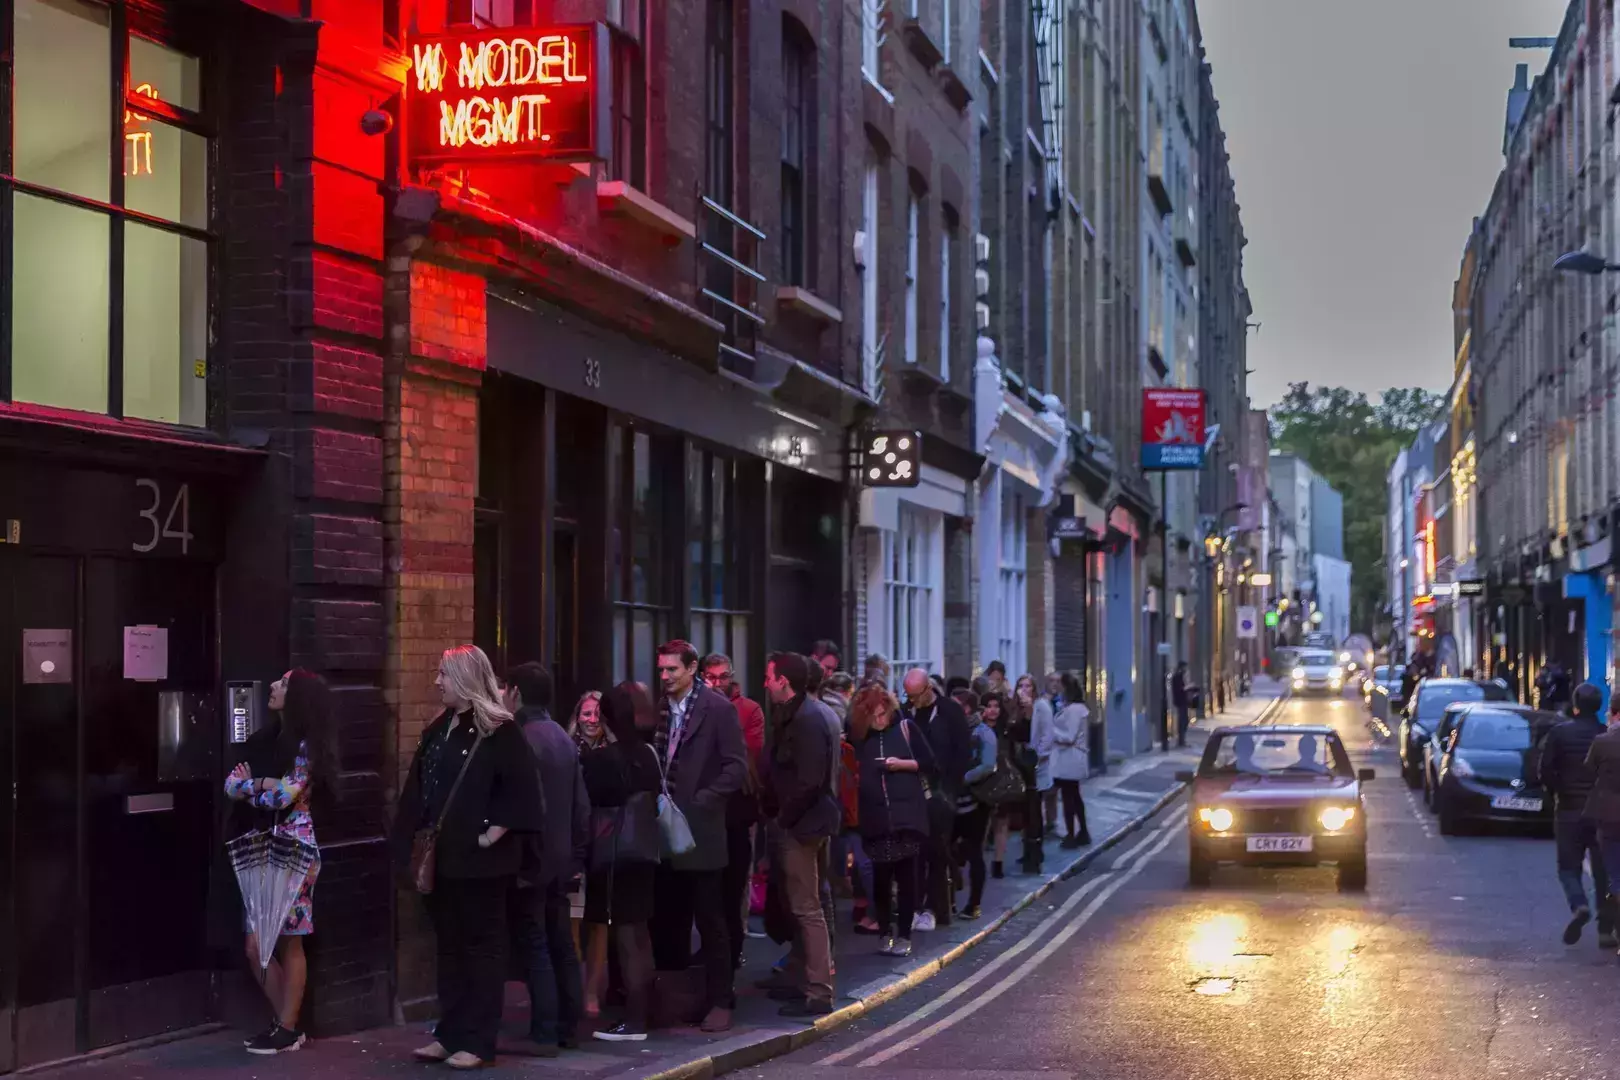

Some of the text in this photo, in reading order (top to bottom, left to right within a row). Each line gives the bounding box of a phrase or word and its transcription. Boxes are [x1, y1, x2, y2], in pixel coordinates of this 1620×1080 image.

[413, 35, 588, 92] W MODEL
[439, 94, 551, 147] MGMT.
[585, 357, 601, 389] 33
[132, 477, 195, 555] 34
[1255, 838, 1278, 850] CRY
